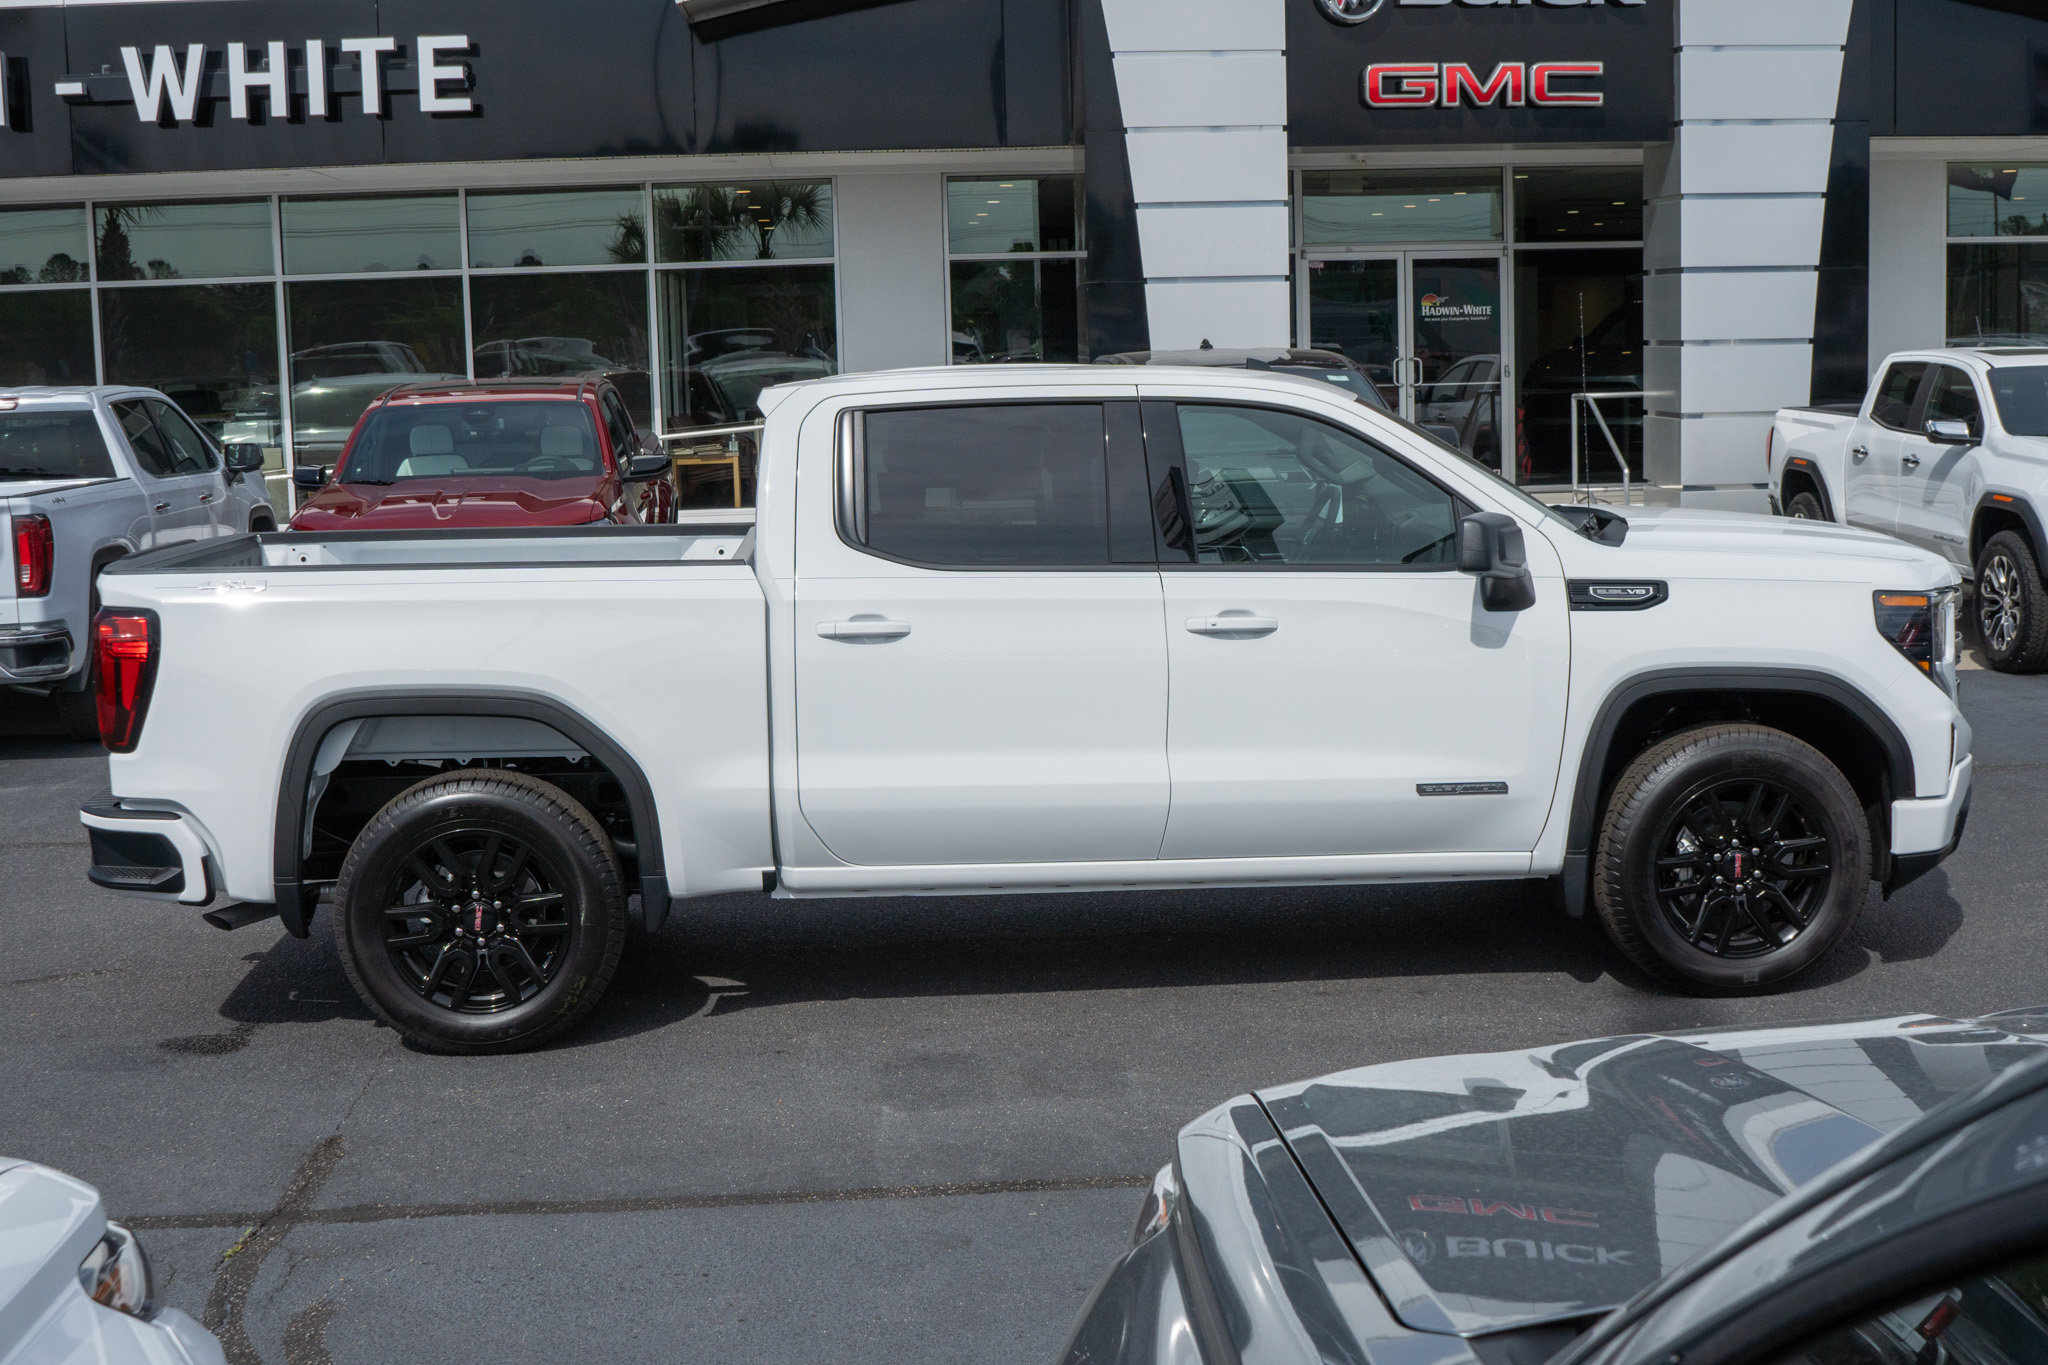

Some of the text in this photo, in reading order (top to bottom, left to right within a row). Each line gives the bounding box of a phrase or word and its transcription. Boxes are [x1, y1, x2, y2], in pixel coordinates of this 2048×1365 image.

[120, 35, 474, 122] WHITE
[1363, 61, 1604, 107] GMC
[1422, 305, 1491, 316] HADWIN-WHITE
